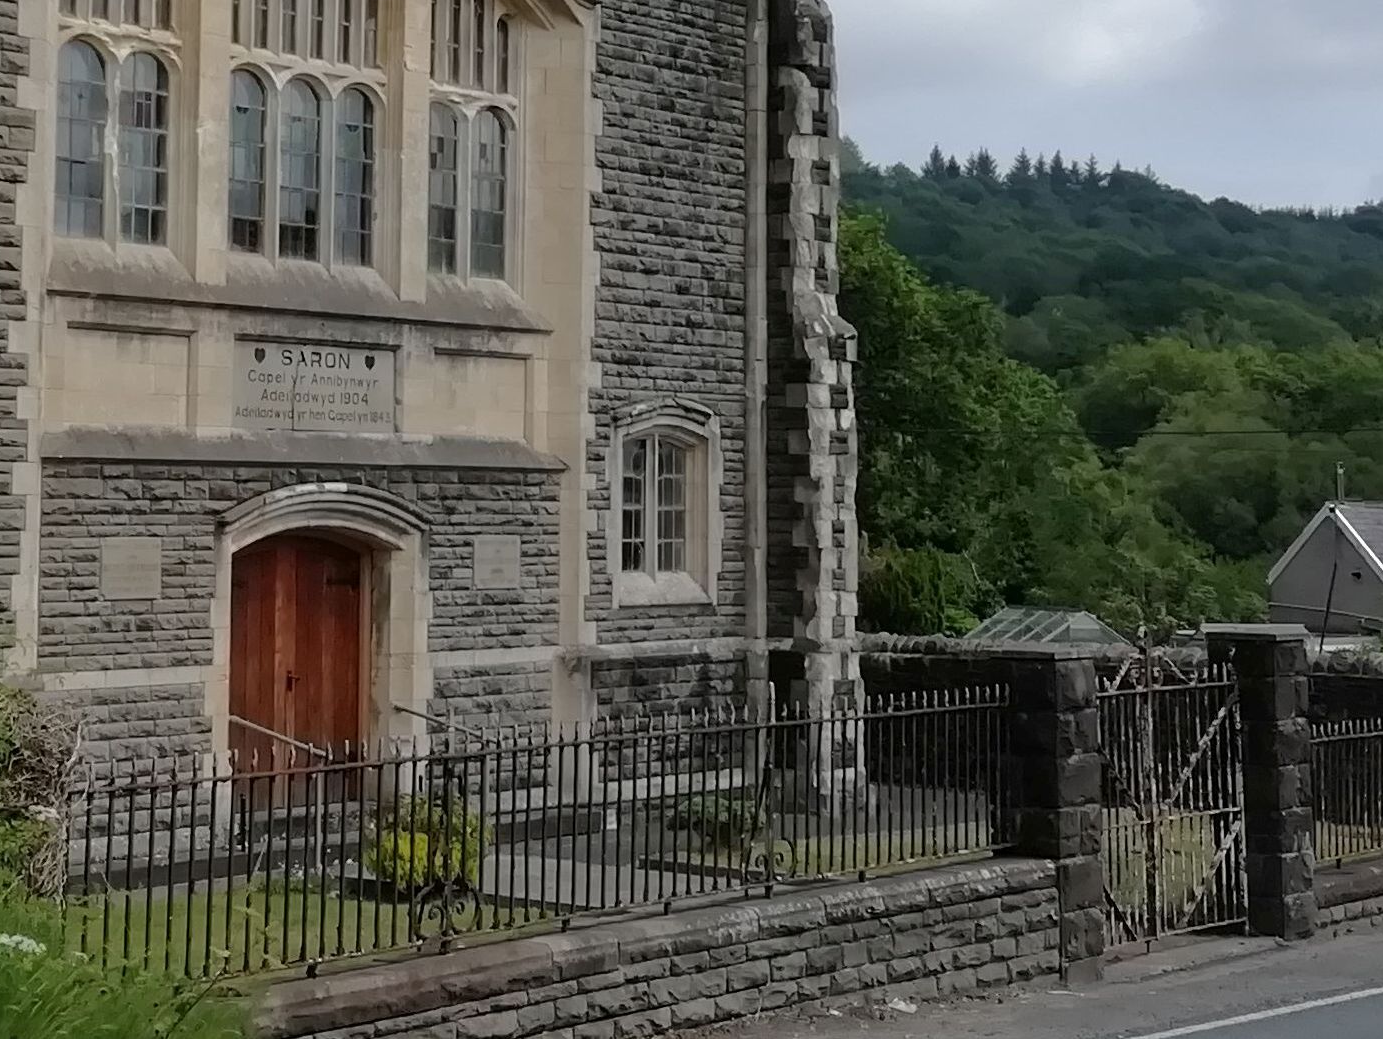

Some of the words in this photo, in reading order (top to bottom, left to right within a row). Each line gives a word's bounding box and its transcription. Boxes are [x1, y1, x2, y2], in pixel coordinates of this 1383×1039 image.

[281, 349, 350, 370] SARON
[247, 369, 286, 384] Capel
[291, 373, 306, 386] yr
[311, 373, 379, 391] Annibynwyr
[340, 392, 369, 406] 1904
